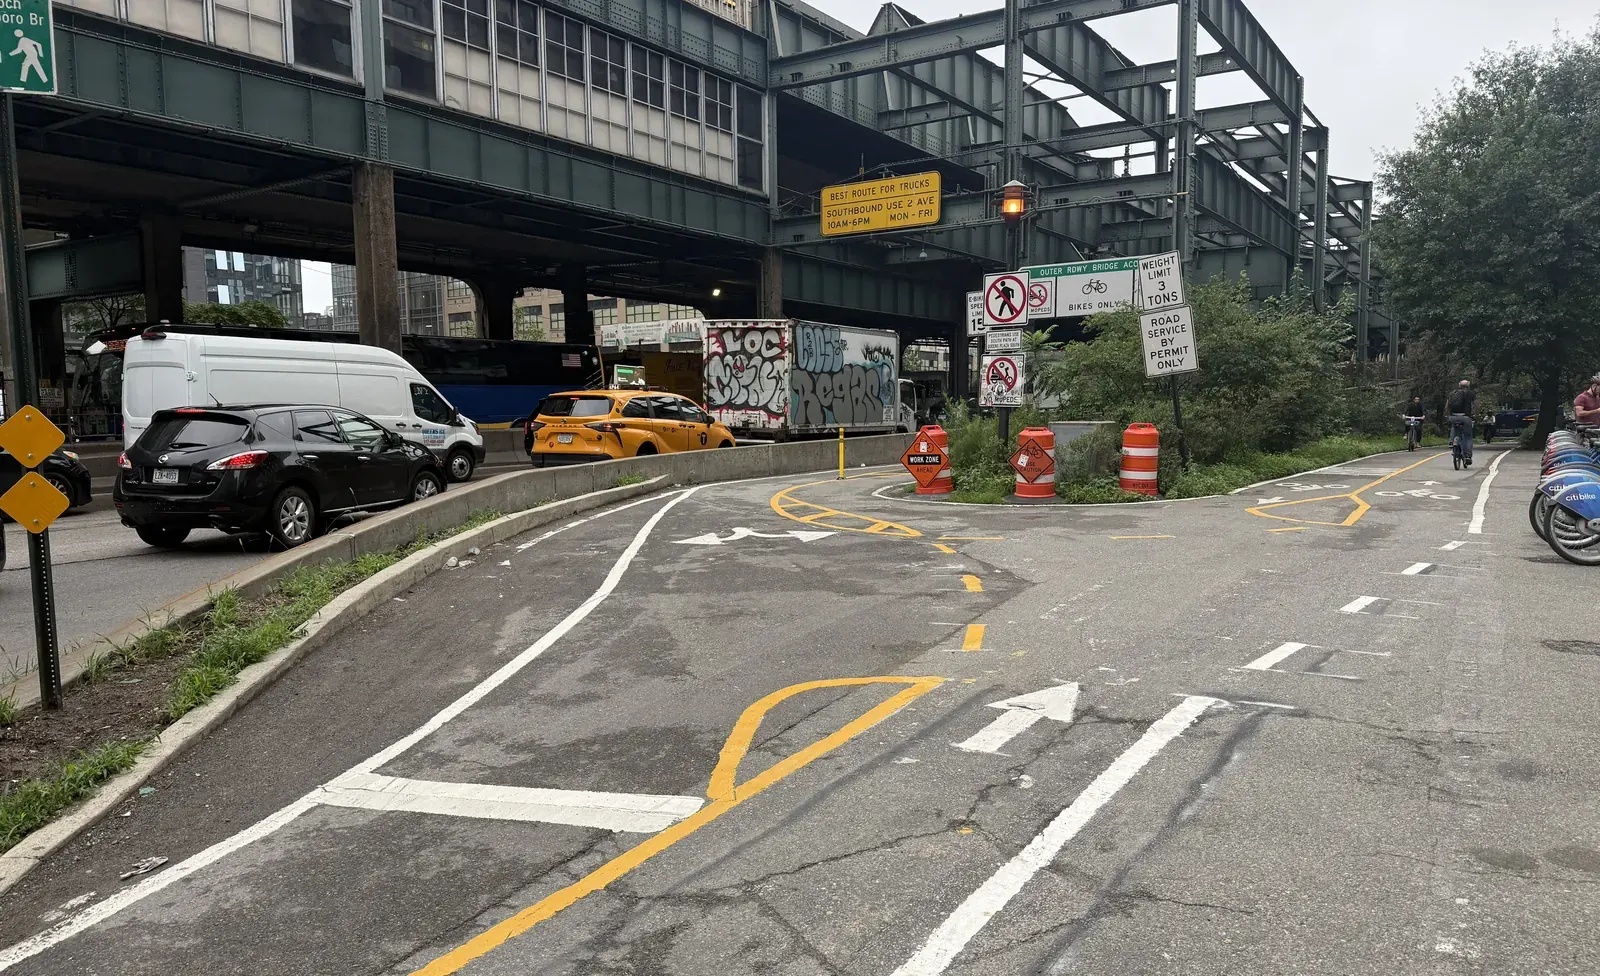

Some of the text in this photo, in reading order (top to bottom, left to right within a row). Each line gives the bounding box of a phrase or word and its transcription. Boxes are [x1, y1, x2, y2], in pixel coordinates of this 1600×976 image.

[0, 12, 44, 26] oro Br
[830, 179, 930, 200] BEST ROUTE FOR TRUCKS
[826, 196, 934, 218] SOUTHBOUND USE 2 AVE
[827, 217, 870, 229] 10AM-6PM
[889, 212, 909, 221] MON
[918, 208, 933, 218] FRI
[1040, 267, 1063, 276] OUTER
[1067, 265, 1087, 274] RDWY
[1092, 262, 1119, 271] BRIDGE
[1141, 255, 1175, 271] WEIGHT
[1148, 267, 1171, 280] LIMIT
[1158, 281, 1166, 291] 3
[1068, 300, 1120, 311] BIKES ONLY
[1148, 291, 1178, 306] TONS
[972, 318, 985, 331] 15
[1151, 314, 1180, 327] ROAD
[1147, 324, 1187, 339] SERVICE
[1161, 337, 1175, 347] BY
[1150, 345, 1189, 360] PERMIT
[1157, 357, 1185, 370] ONLY
[925, 455, 940, 463] ZONE
